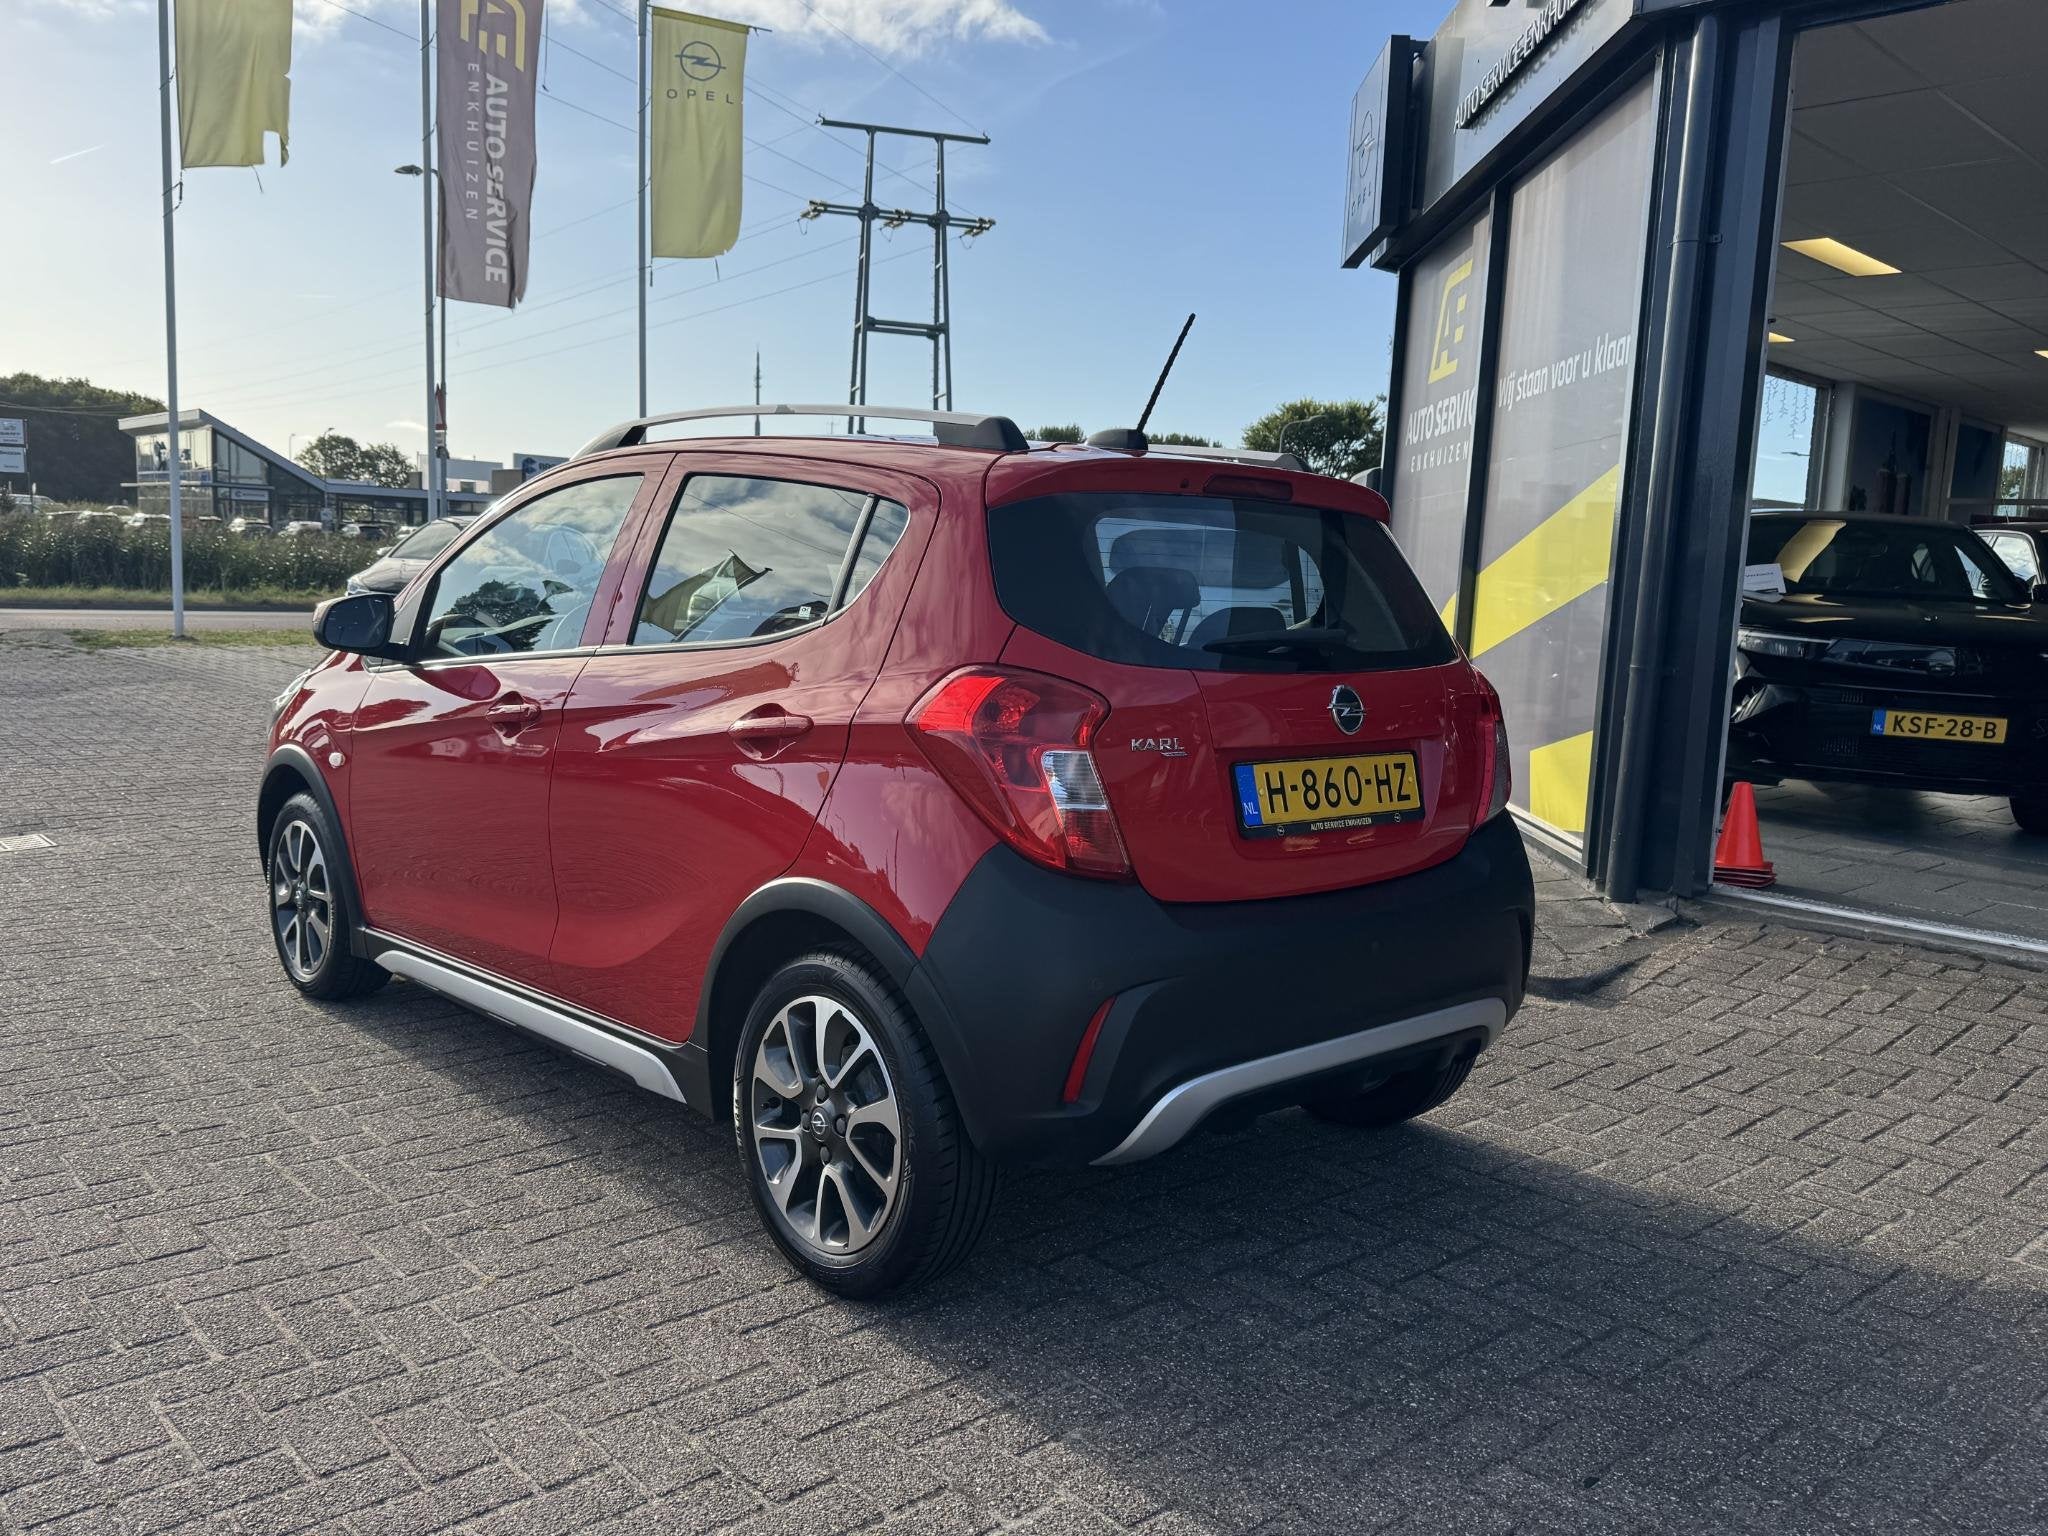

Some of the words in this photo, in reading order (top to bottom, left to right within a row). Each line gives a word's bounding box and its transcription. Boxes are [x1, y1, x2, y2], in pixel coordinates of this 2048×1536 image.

[666, 88, 734, 105] OPEL
[1453, 86, 1480, 134] AUTO
[466, 63, 480, 220] ENKHUIZEN
[1515, 368, 1548, 402] staan
[1551, 353, 1581, 389] voor
[1582, 349, 1592, 379] u
[1593, 332, 1631, 376] klaar
[1434, 385, 1476, 437] SERVIC
[1410, 441, 1469, 473] ENKHUIZEN
[1892, 714, 1998, 739] KSF-28-B
[1131, 737, 1185, 751] KARL
[1264, 762, 1411, 814] H-860-HZ
[1243, 802, 1259, 815] NL
[1310, 822, 1324, 831] AUTO
[1324, 820, 1345, 829] SERVICE
